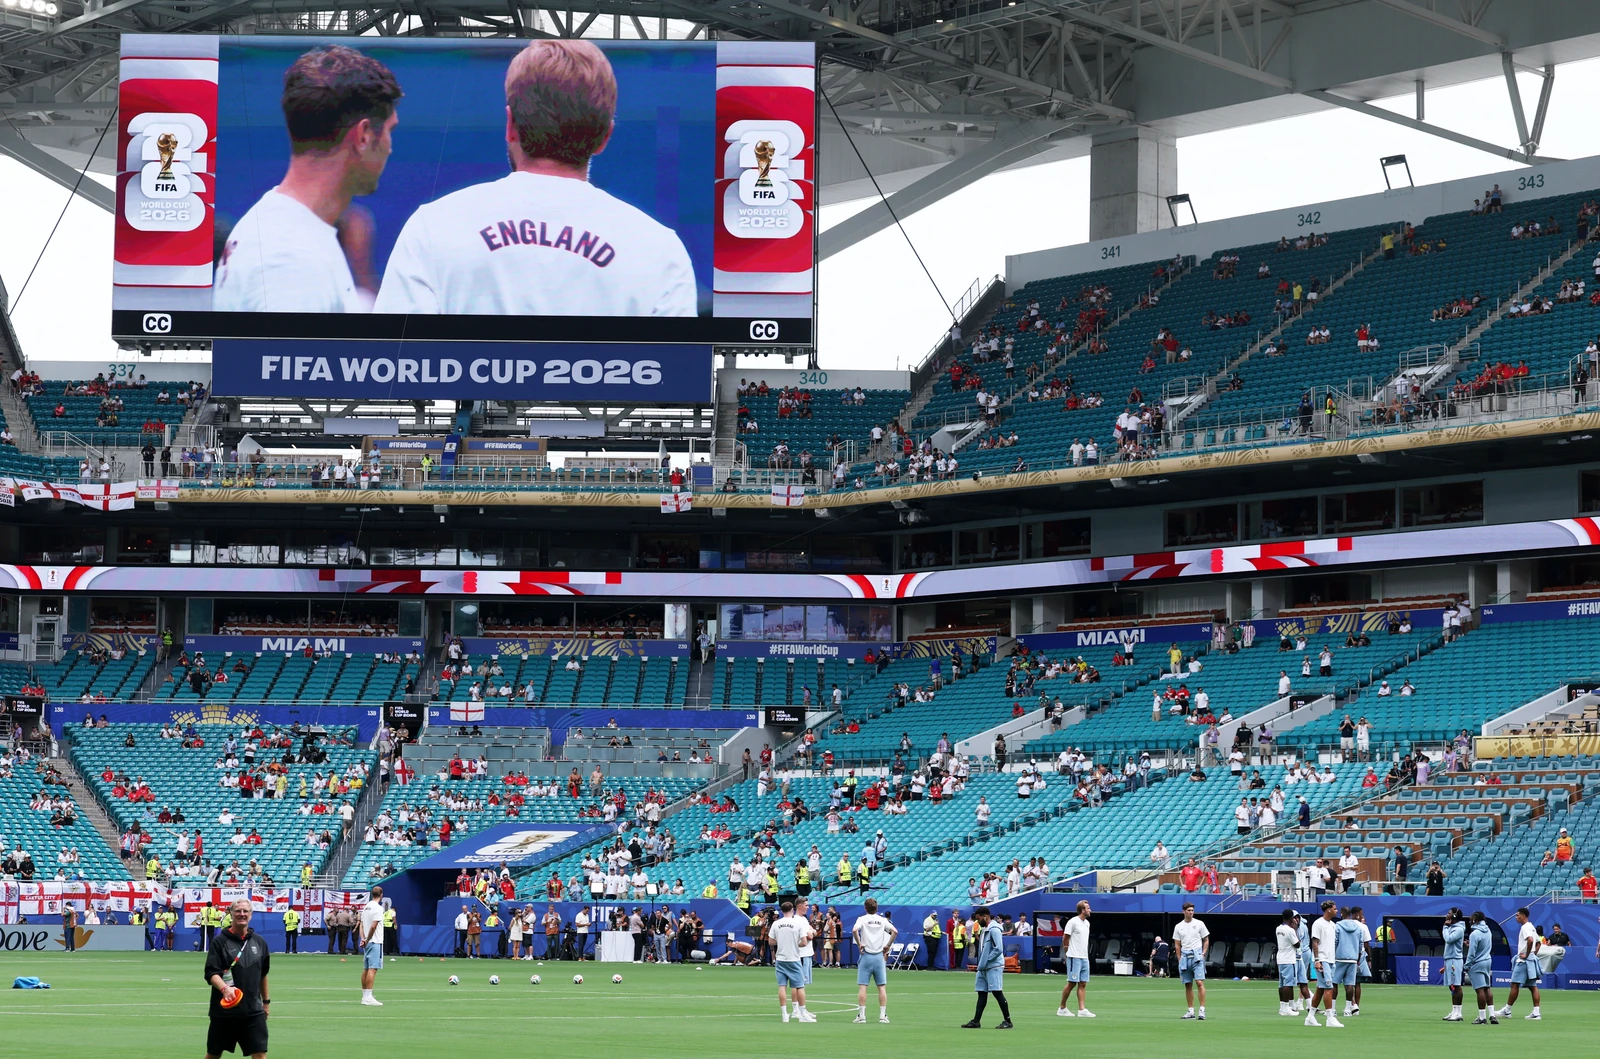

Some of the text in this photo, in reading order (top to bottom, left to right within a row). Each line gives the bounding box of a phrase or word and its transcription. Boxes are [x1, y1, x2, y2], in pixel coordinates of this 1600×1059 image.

[155, 183, 177, 192] FIFA
[1518, 173, 1544, 191] 343
[753, 190, 776, 199] FIFA
[140, 201, 190, 209] WORLD CUP
[739, 208, 789, 216] WORLD CUP
[139, 210, 190, 221] 2026
[738, 217, 789, 228] 2026
[1297, 211, 1321, 227] 342
[479, 218, 616, 269] ENGLAND
[1101, 245, 1121, 260] 341
[145, 315, 169, 331] CC
[752, 322, 776, 338] CC
[108, 363, 136, 377] 337
[261, 355, 662, 385] FIFA WORLD CUP 2026
[799, 371, 828, 385] 340
[388, 441, 427, 450] #FIFAWorldCup
[484, 442, 522, 450] #FIFAWorldCup
[262, 637, 345, 651] MIAMI
[1077, 629, 1145, 647] MIAMI
[769, 644, 839, 657] #FIFAWorldCup
